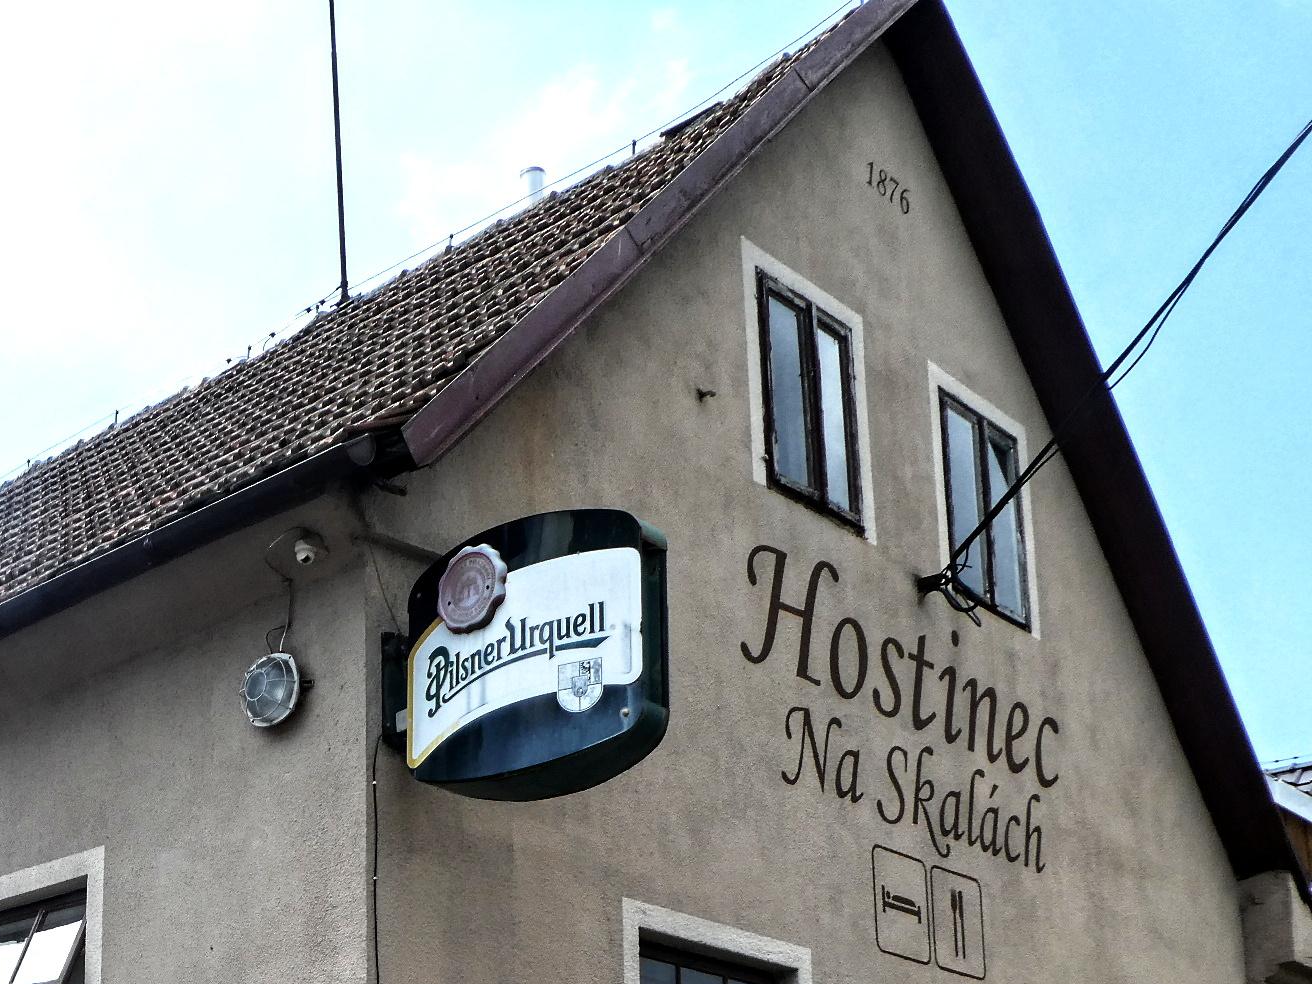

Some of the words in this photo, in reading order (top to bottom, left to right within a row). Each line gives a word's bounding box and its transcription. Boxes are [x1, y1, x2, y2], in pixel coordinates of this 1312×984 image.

[866, 161, 910, 215] 1876
[425, 635, 508, 718] Pilsner
[505, 600, 605, 660] Urquell
[740, 544, 1059, 788] Hostinec
[781, 706, 864, 803] Na
[876, 745, 1046, 873] Skalách
